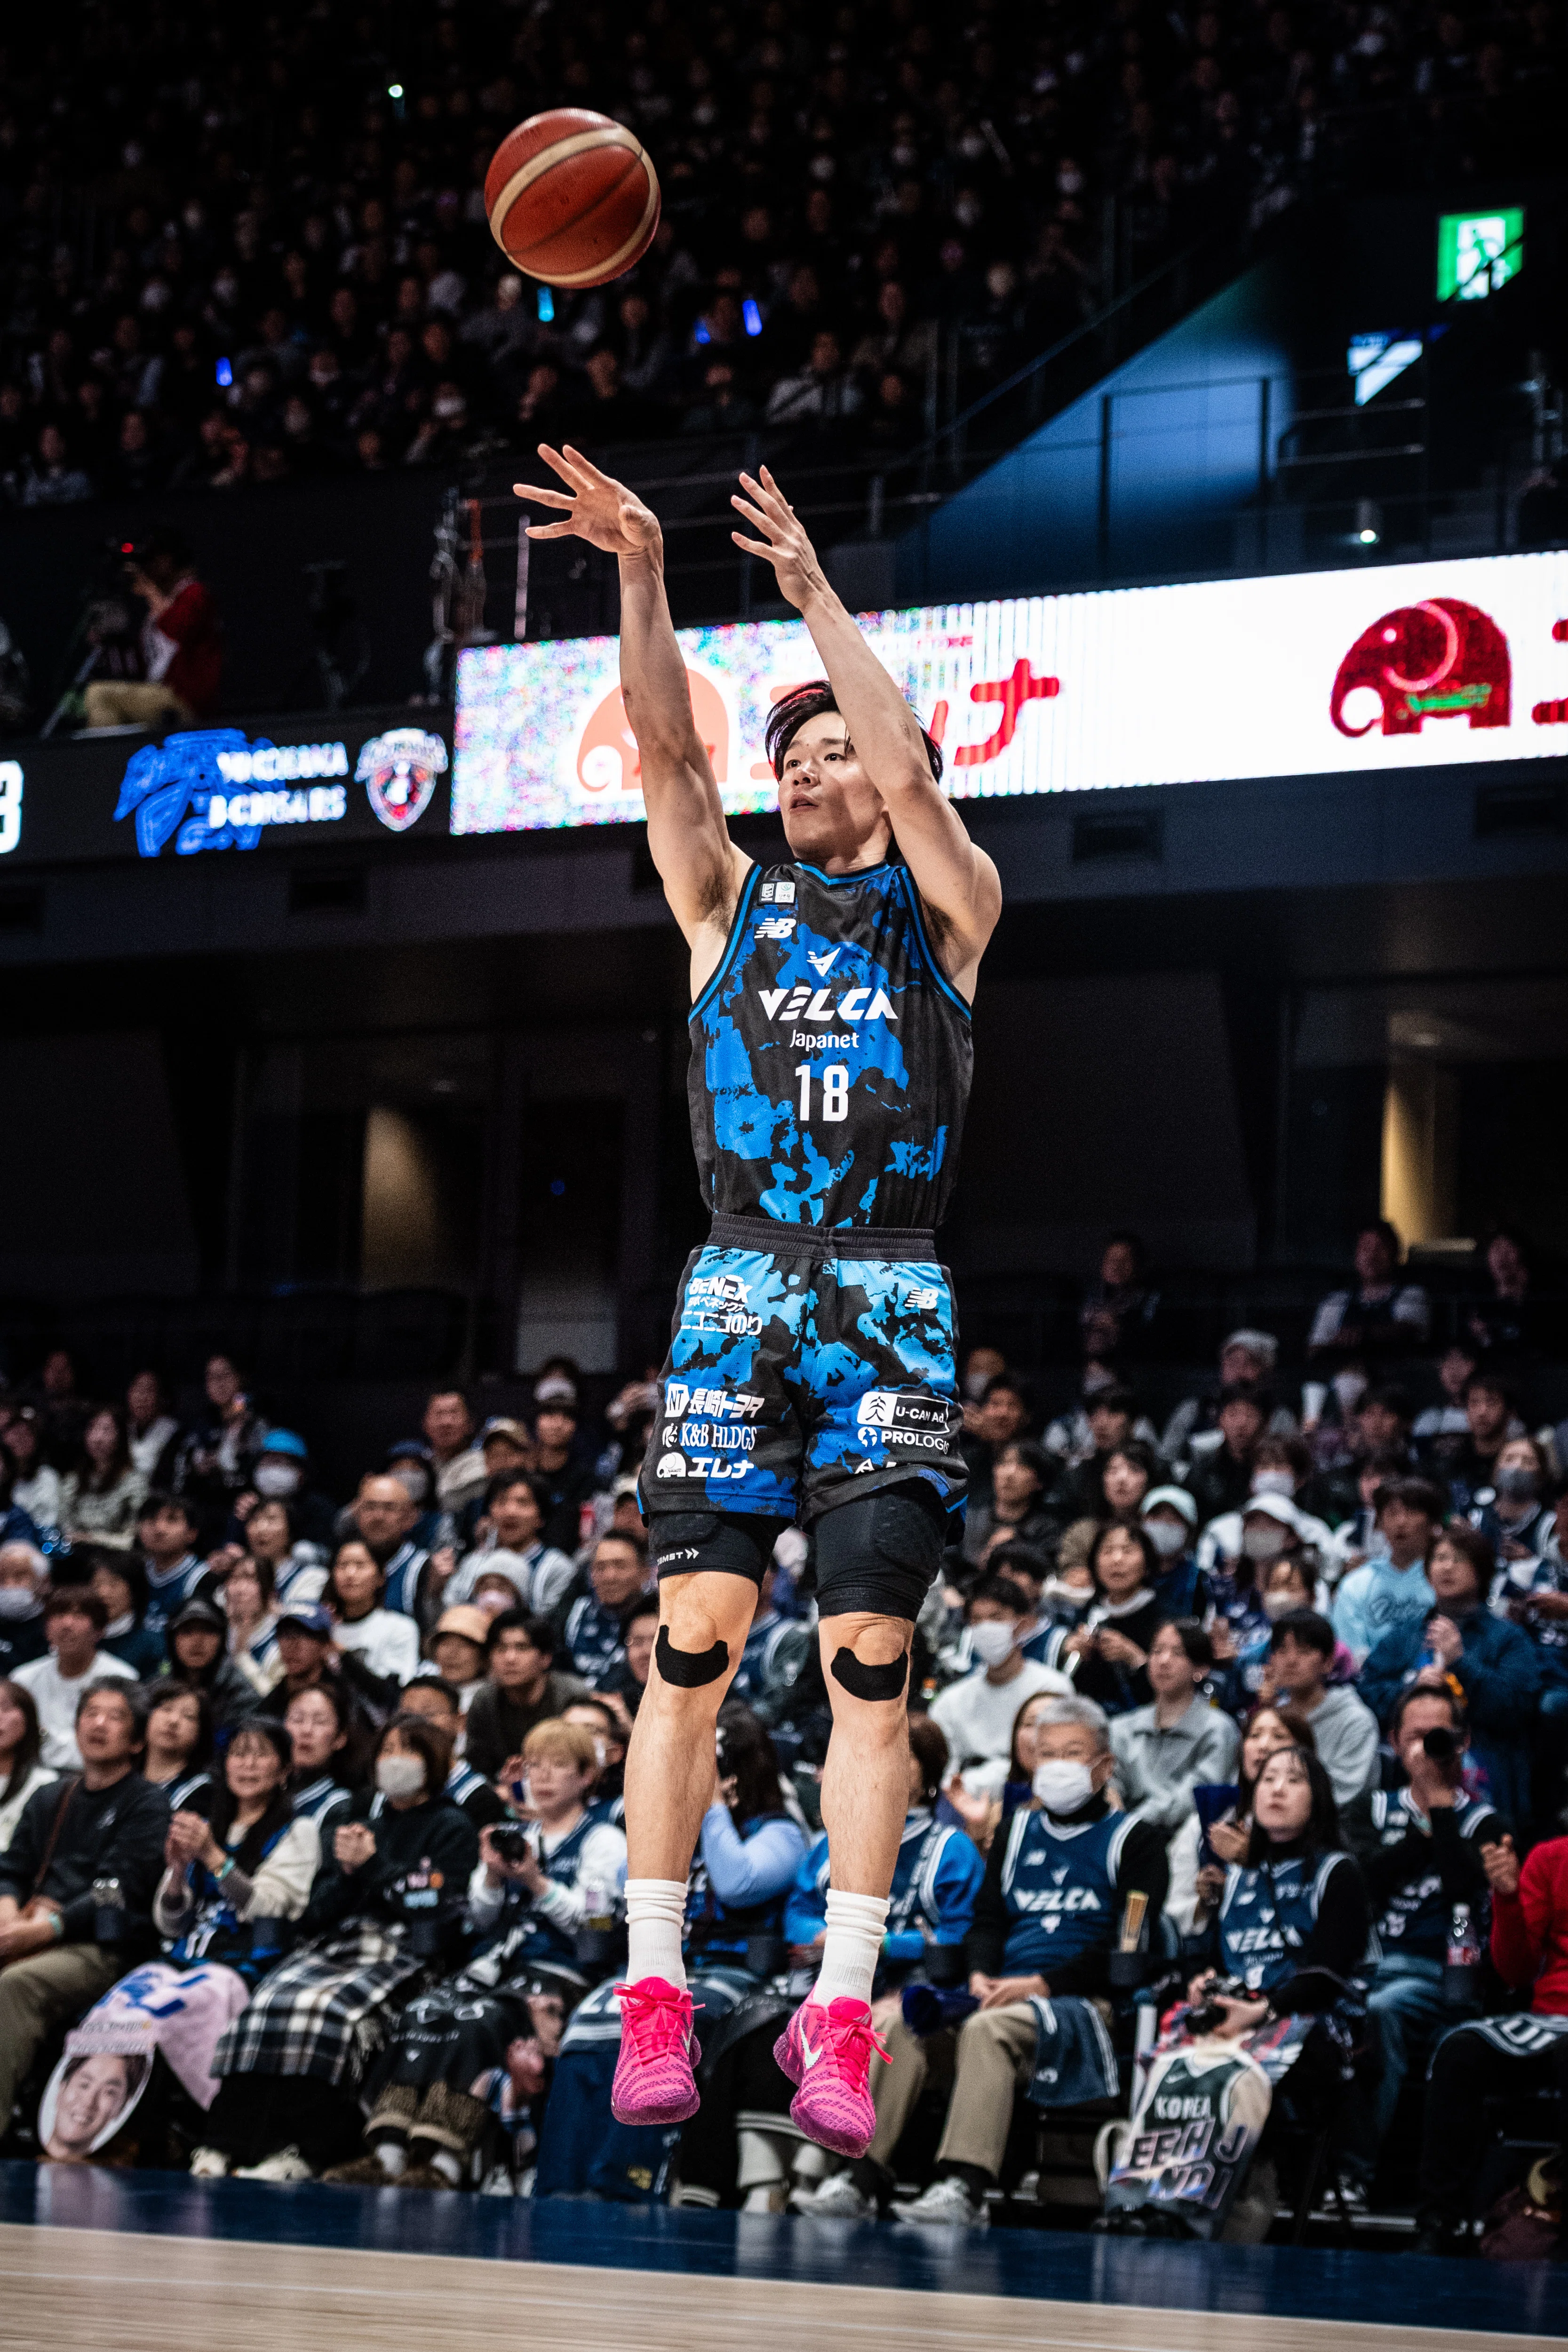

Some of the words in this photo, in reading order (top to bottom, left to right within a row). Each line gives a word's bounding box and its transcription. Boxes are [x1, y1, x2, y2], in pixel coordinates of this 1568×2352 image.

[758, 986, 899, 1021] VELCA
[789, 1029, 860, 1052] Japanet
[795, 1064, 849, 1122] 18
[689, 1276, 753, 1303] BENEX
[680, 1310, 763, 1336] ニコニコのり
[687, 1388, 765, 1418] 長崎トヨタ
[680, 1422, 709, 1447] K&B
[711, 1423, 757, 1451] HLDGS
[881, 1430, 950, 1455] PROLOGIS
[687, 1457, 755, 1479] エレナ
[1013, 1887, 1101, 1911] VELCA
